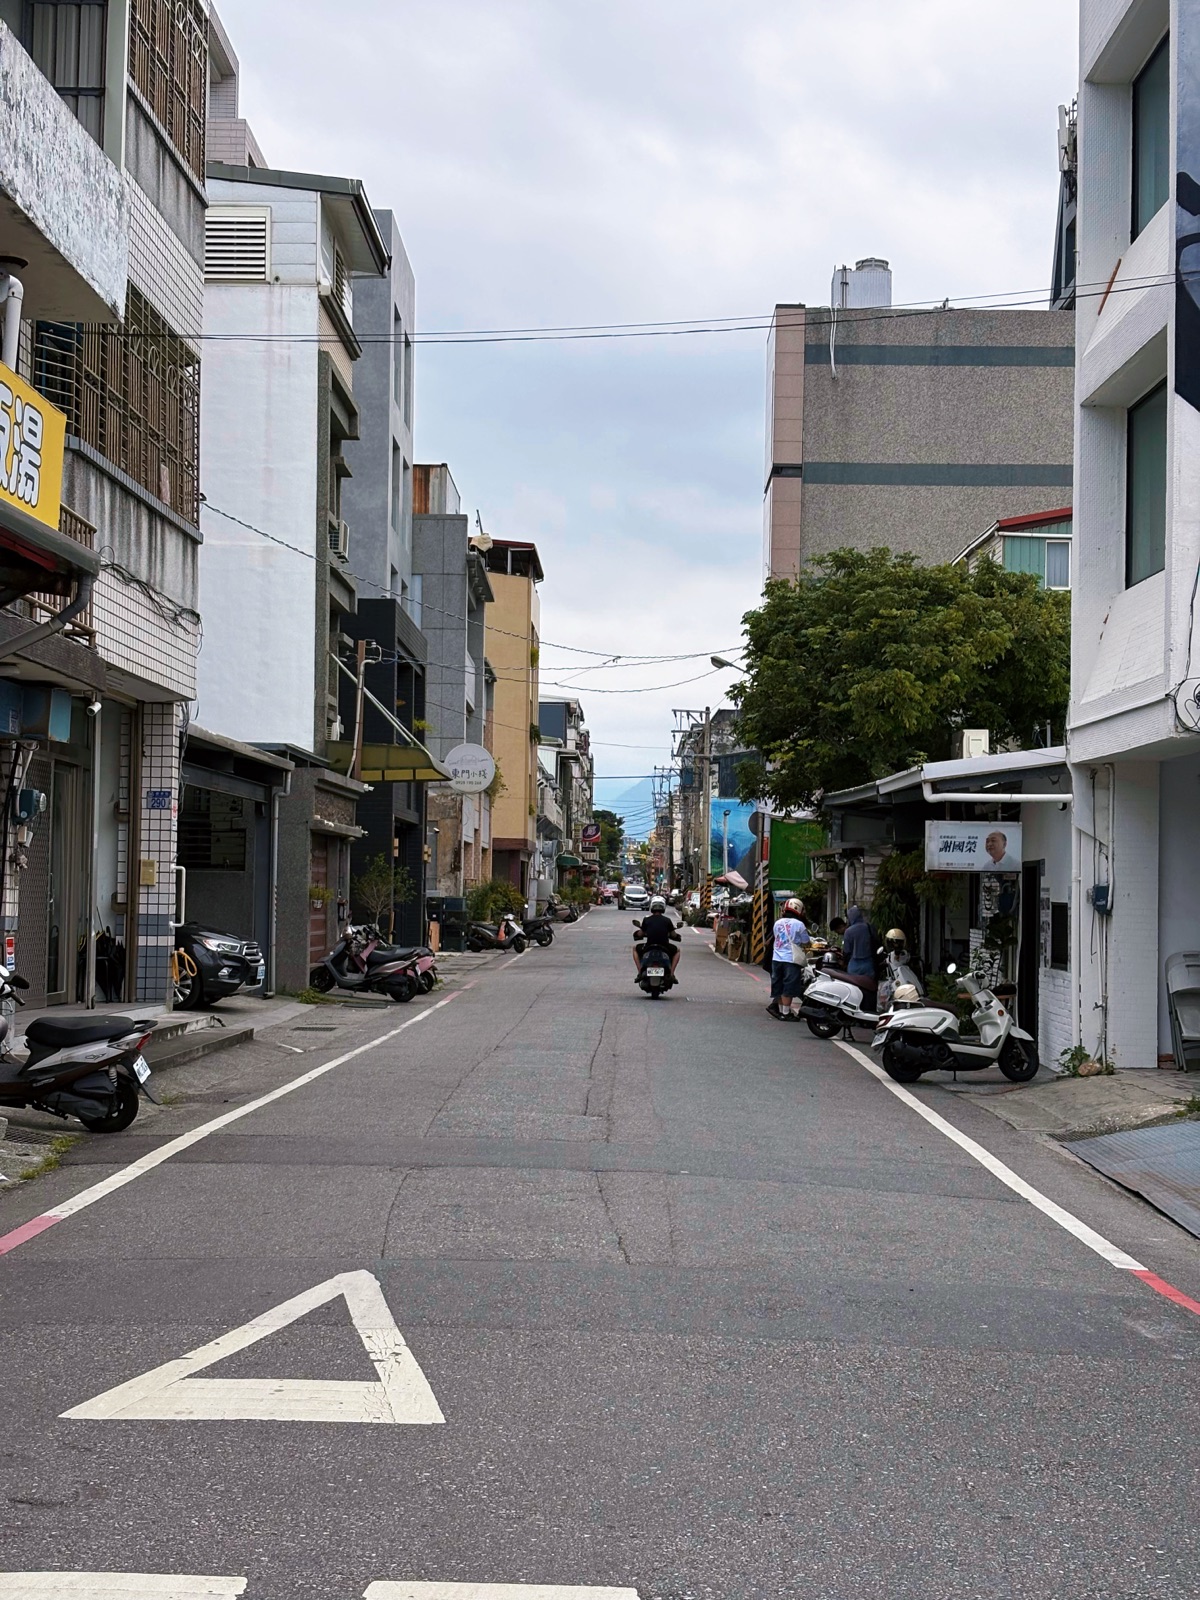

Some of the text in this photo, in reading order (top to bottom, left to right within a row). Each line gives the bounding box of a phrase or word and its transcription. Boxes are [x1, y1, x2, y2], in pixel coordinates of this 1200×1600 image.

[151, 798, 166, 808] 290
[939, 840, 977, 853] 謝國榮
